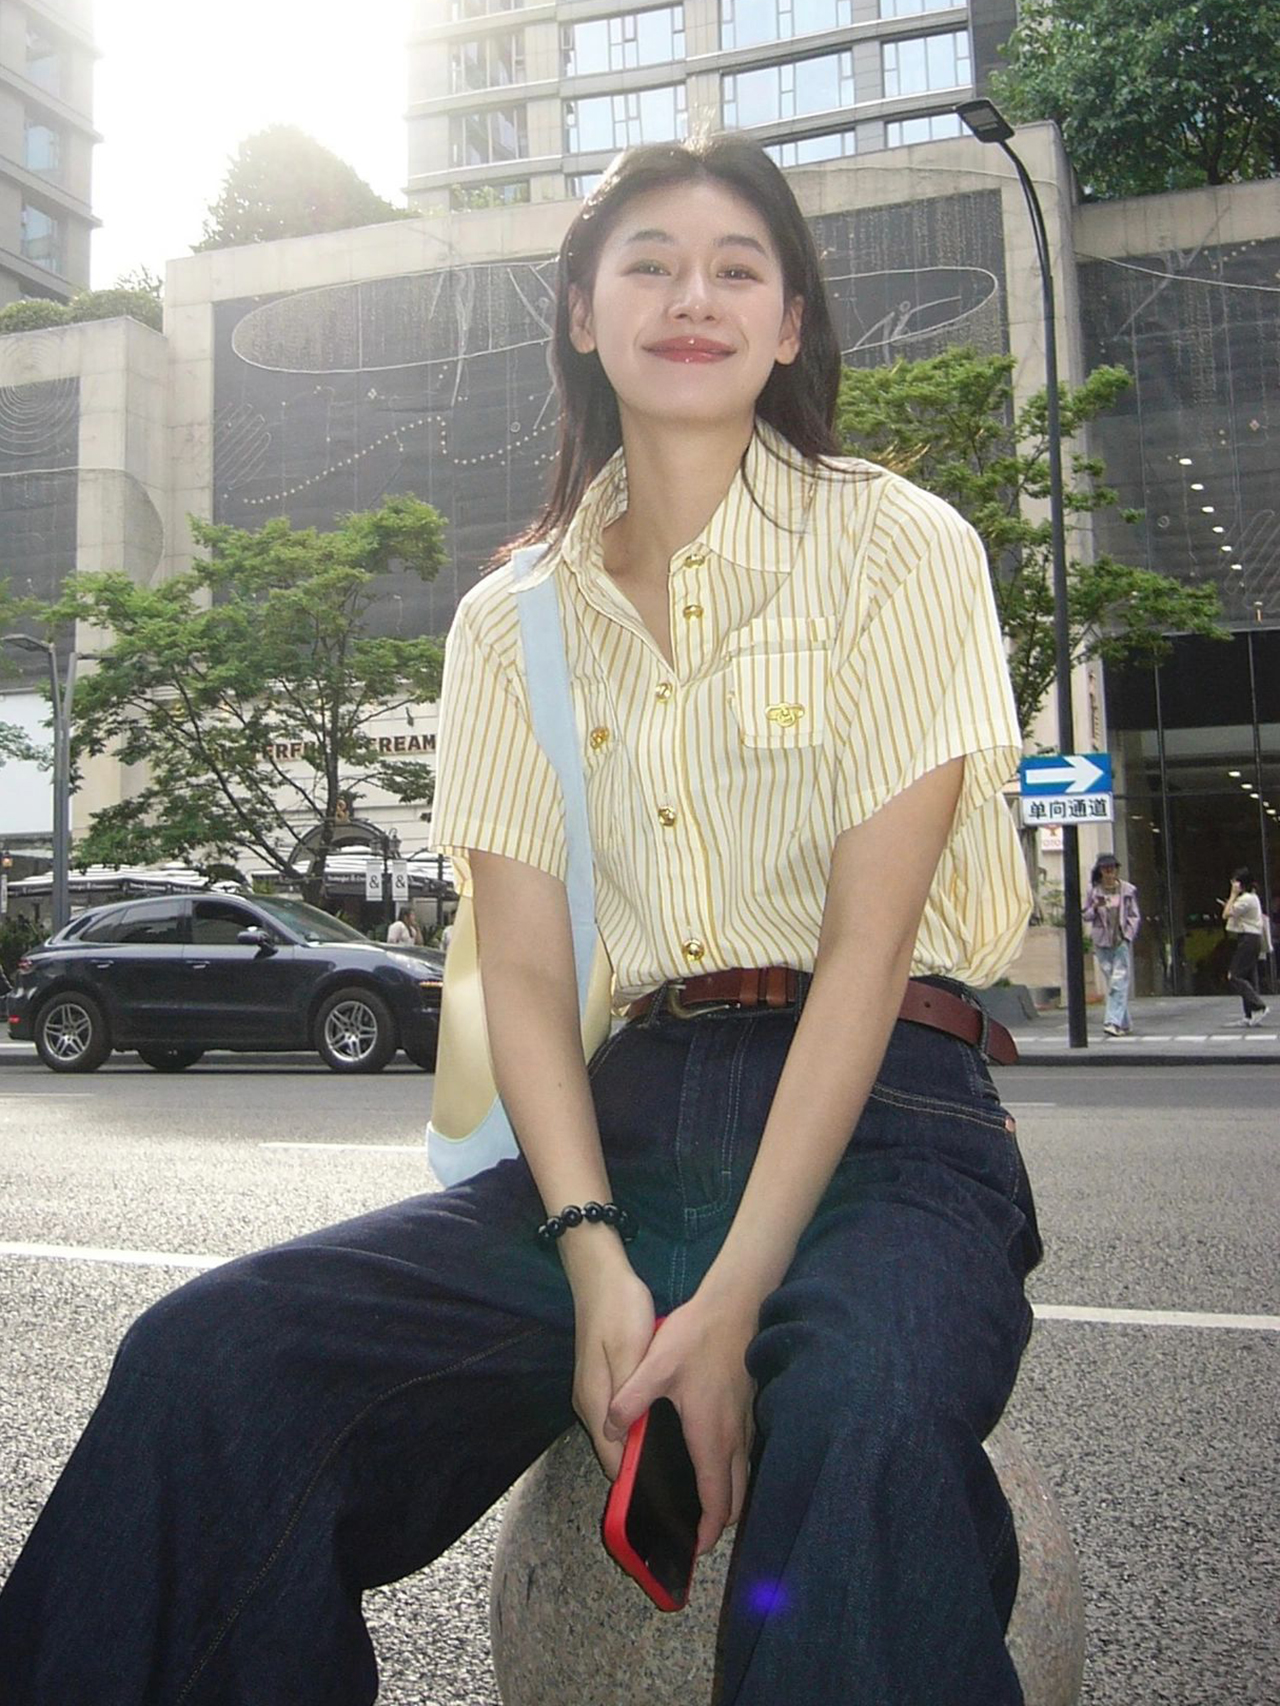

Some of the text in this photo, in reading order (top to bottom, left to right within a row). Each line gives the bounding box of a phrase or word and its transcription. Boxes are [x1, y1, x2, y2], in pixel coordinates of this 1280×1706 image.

[1028, 798, 1107, 819] 单向通道
[369, 875, 380, 889] &
[395, 875, 406, 889] &
